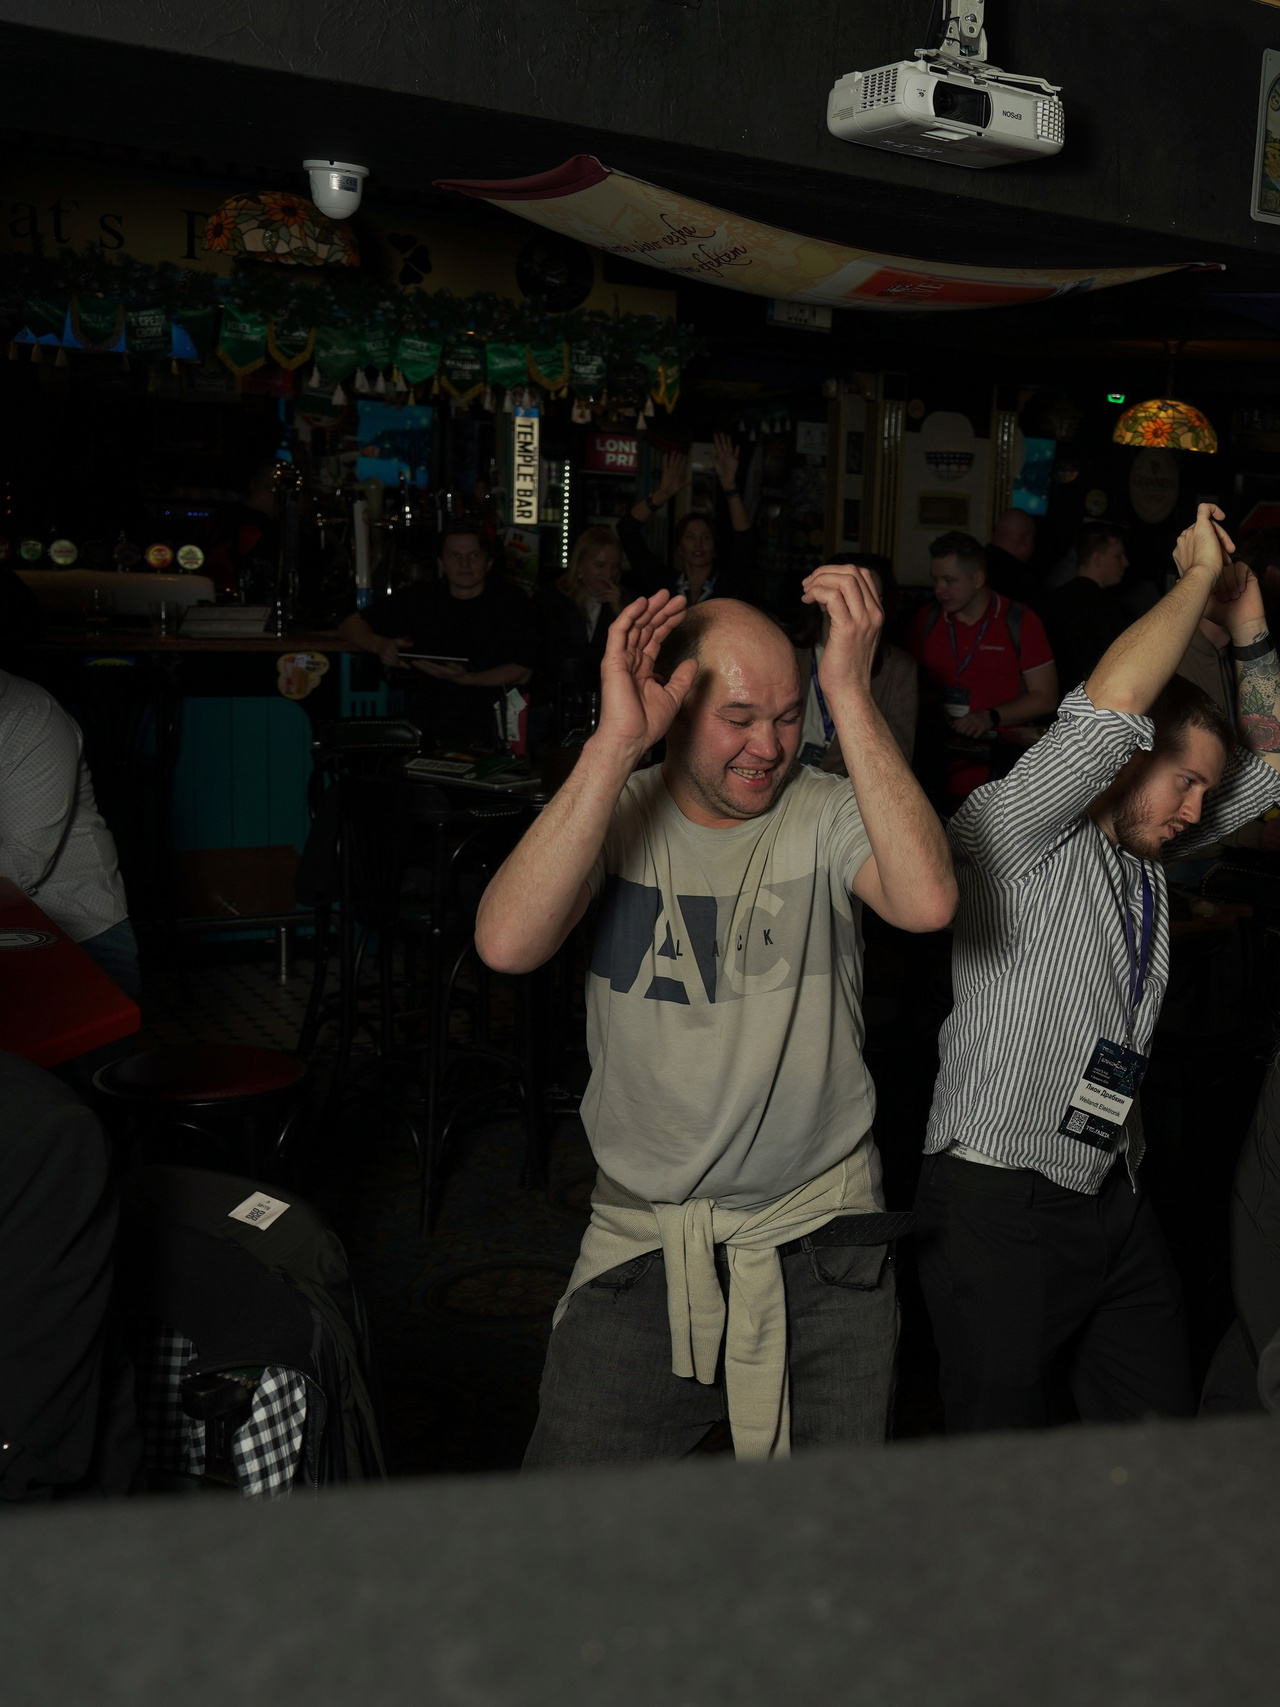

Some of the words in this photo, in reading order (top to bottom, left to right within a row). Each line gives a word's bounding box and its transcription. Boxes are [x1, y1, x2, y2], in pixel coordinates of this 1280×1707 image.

[1002, 110, 1022, 120] EPSON
[8, 197, 124, 250] at's
[517, 422, 534, 482] TEMPLE
[595, 438, 638, 453] LOND
[605, 453, 636, 466] PRI
[516, 488, 533, 519] BAR
[652, 928, 773, 957] LACK
[1086, 1083, 1101, 1095] Лион
[1100, 1089, 1126, 1105] Драбкин
[1099, 1102, 1121, 1118] Elektronik
